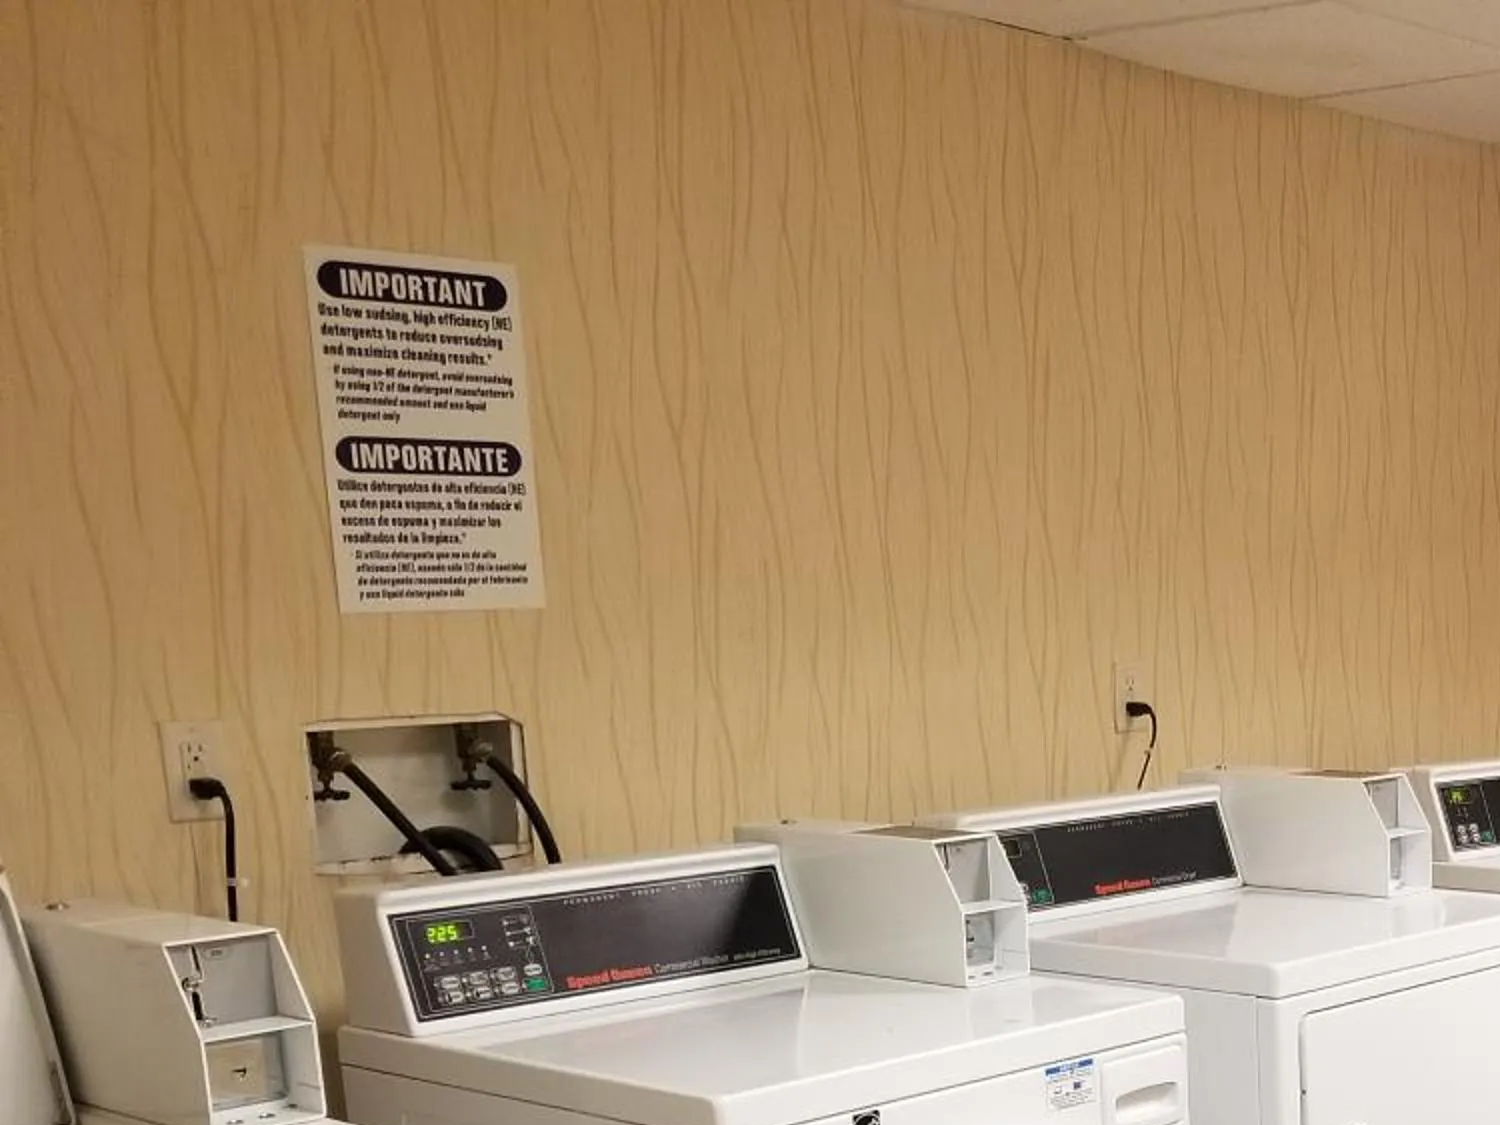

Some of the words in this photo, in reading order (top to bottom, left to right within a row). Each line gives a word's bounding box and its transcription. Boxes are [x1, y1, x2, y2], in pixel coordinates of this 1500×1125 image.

[340, 268, 486, 307] IMPORTANT
[318, 301, 339, 316] Use
[342, 304, 362, 318] low
[413, 311, 436, 327] high
[438, 312, 489, 331] efficiency
[320, 323, 382, 340] detergents
[385, 328, 398, 340] to
[399, 329, 437, 343] reduce
[440, 334, 502, 350] oversudsing
[323, 342, 343, 355] and
[346, 345, 399, 359] maximize
[401, 348, 447, 365] cleaning
[342, 366, 365, 378] using
[335, 380, 345, 391] by
[347, 381, 370, 392] using
[386, 383, 395, 391] of
[397, 383, 410, 392] the
[412, 384, 452, 396] detergent
[336, 395, 399, 408] recommended
[338, 408, 380, 422] detergent
[382, 411, 400, 424] only
[351, 443, 509, 473] IMPORTANTE
[431, 482, 442, 493] de
[426, 925, 457, 944] 225
[566, 971, 609, 989] Speed
[610, 965, 652, 982] Queen
